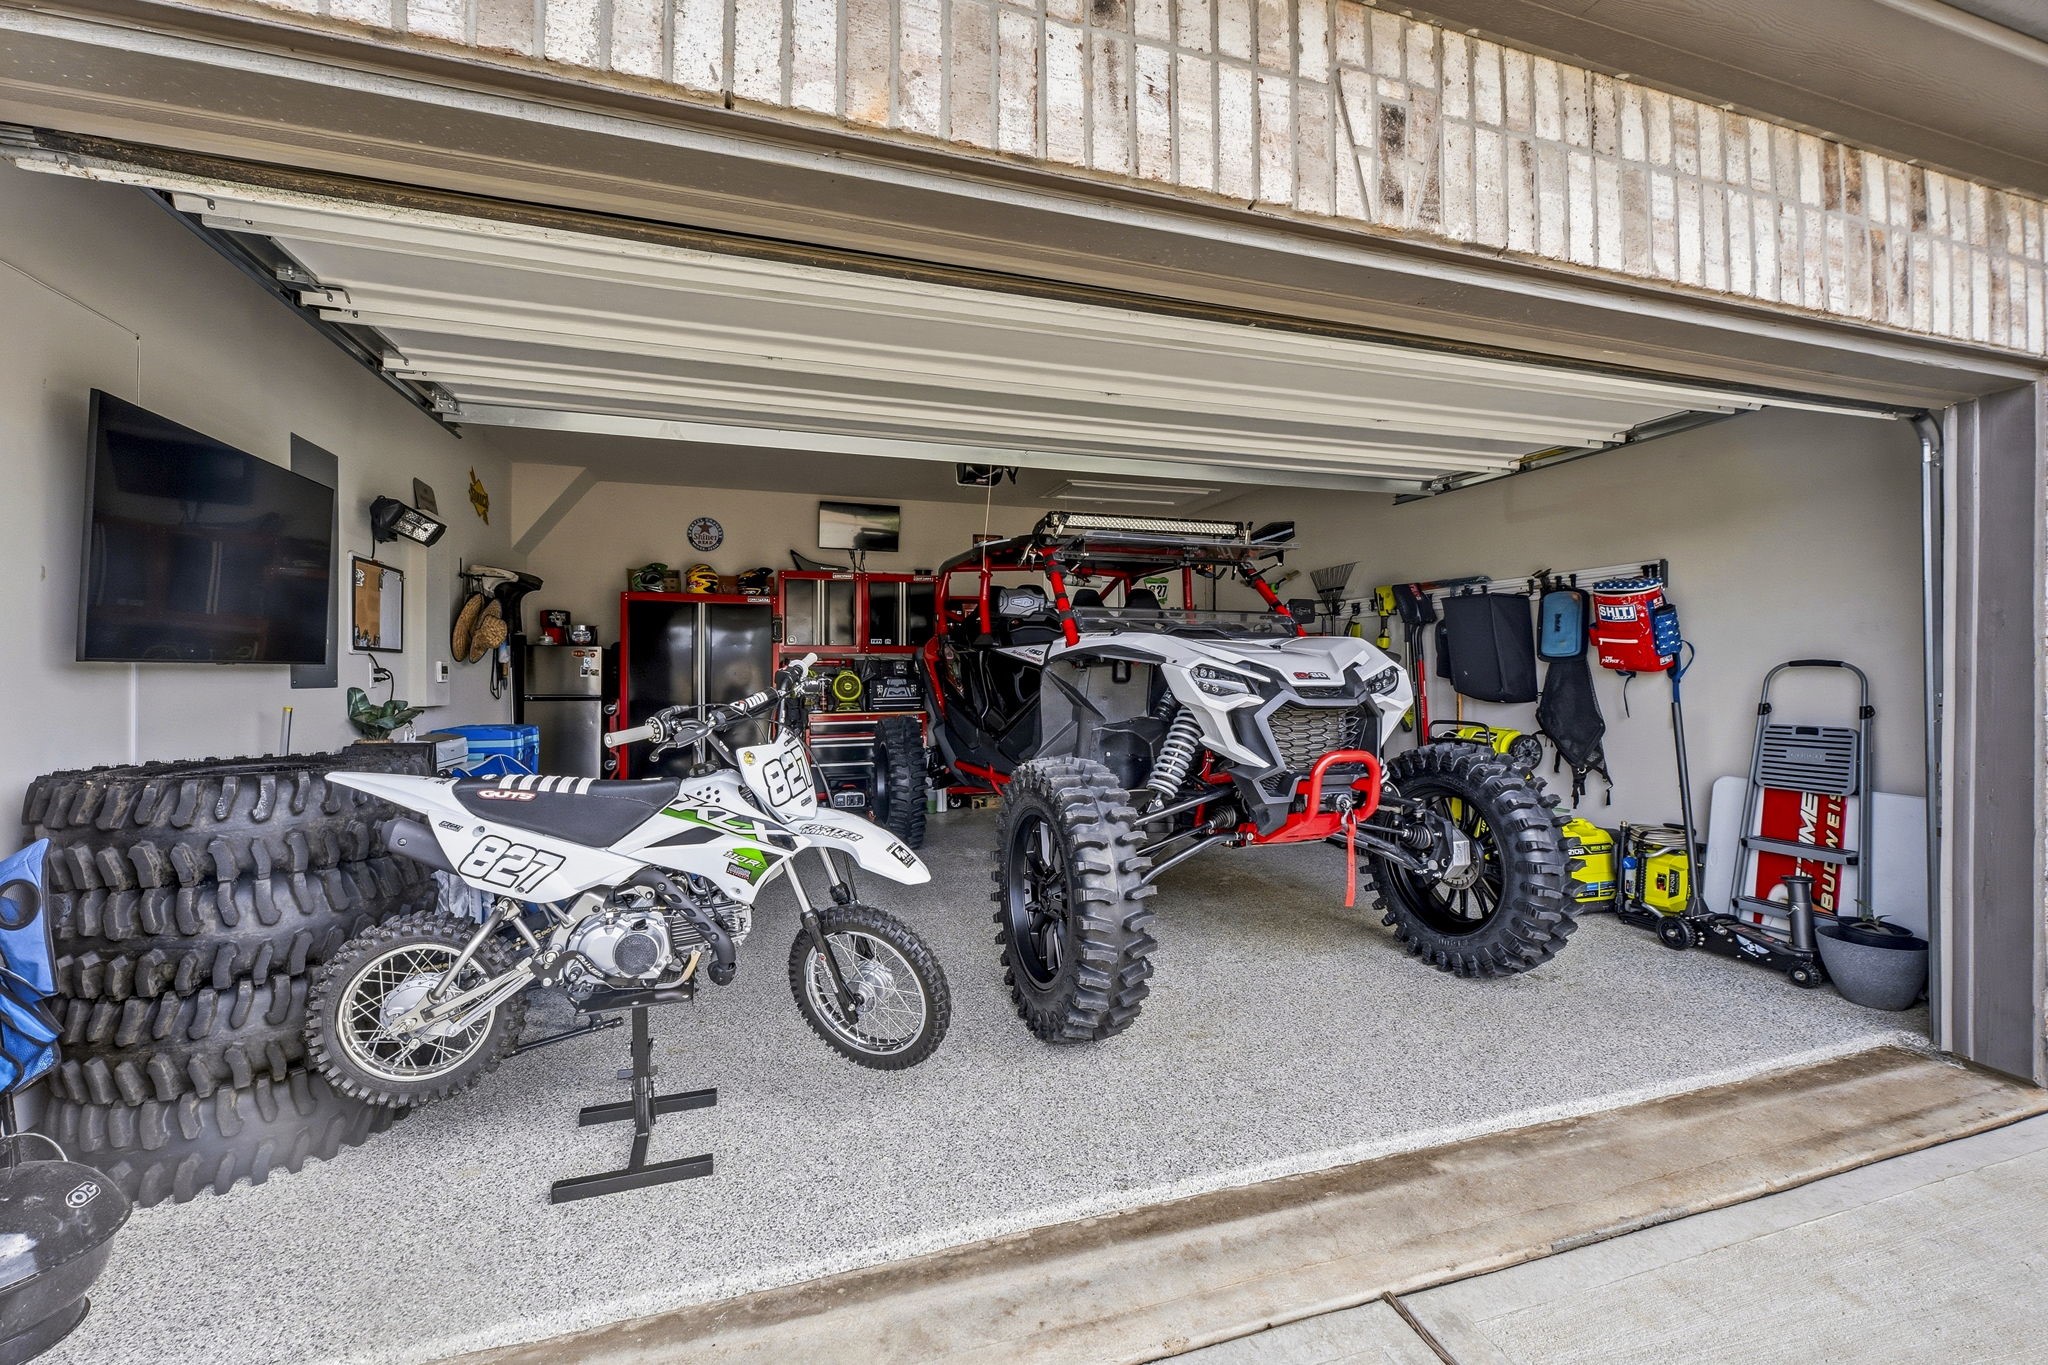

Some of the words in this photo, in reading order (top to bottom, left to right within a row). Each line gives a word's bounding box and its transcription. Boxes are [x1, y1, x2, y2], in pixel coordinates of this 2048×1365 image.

[478, 790, 537, 800] GUTS
[763, 744, 815, 808] 827
[458, 834, 567, 894] 827
